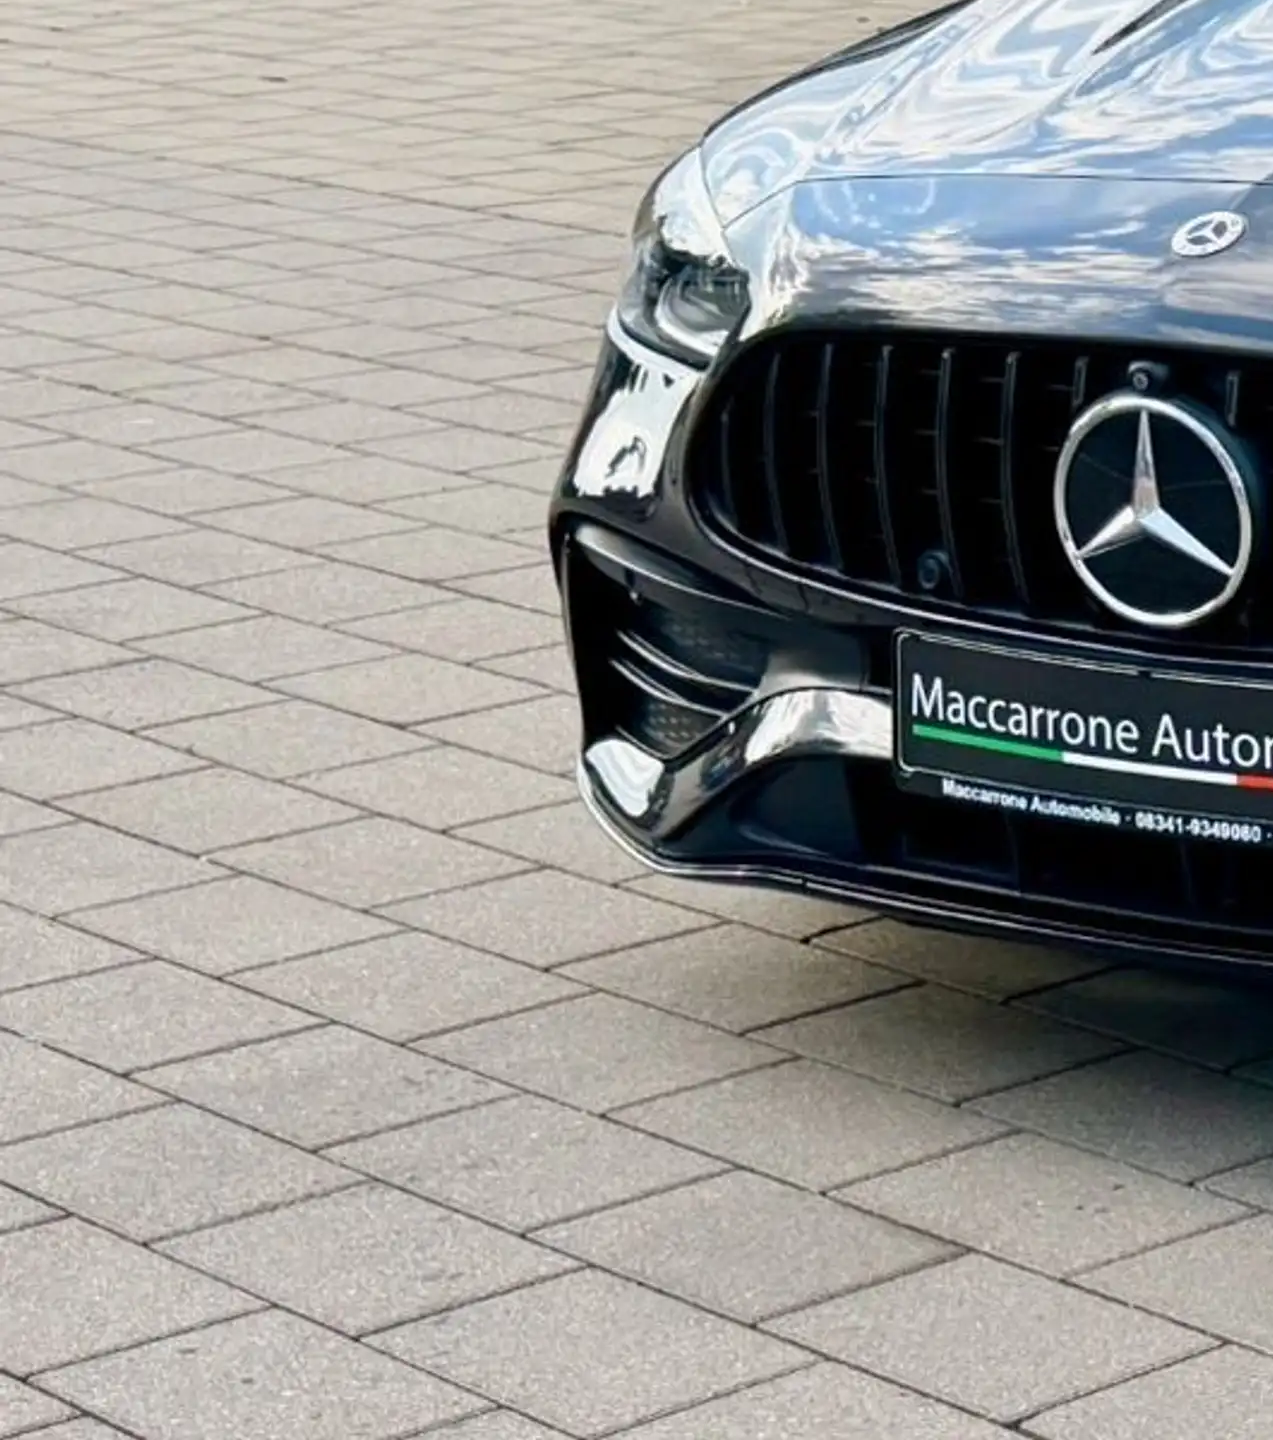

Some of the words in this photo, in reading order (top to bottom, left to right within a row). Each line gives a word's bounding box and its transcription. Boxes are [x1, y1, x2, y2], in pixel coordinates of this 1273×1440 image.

[911, 672, 1140, 754] Maccarrone
[942, 777, 1028, 811] Maccarrone
[1031, 794, 1122, 827] Automobile
